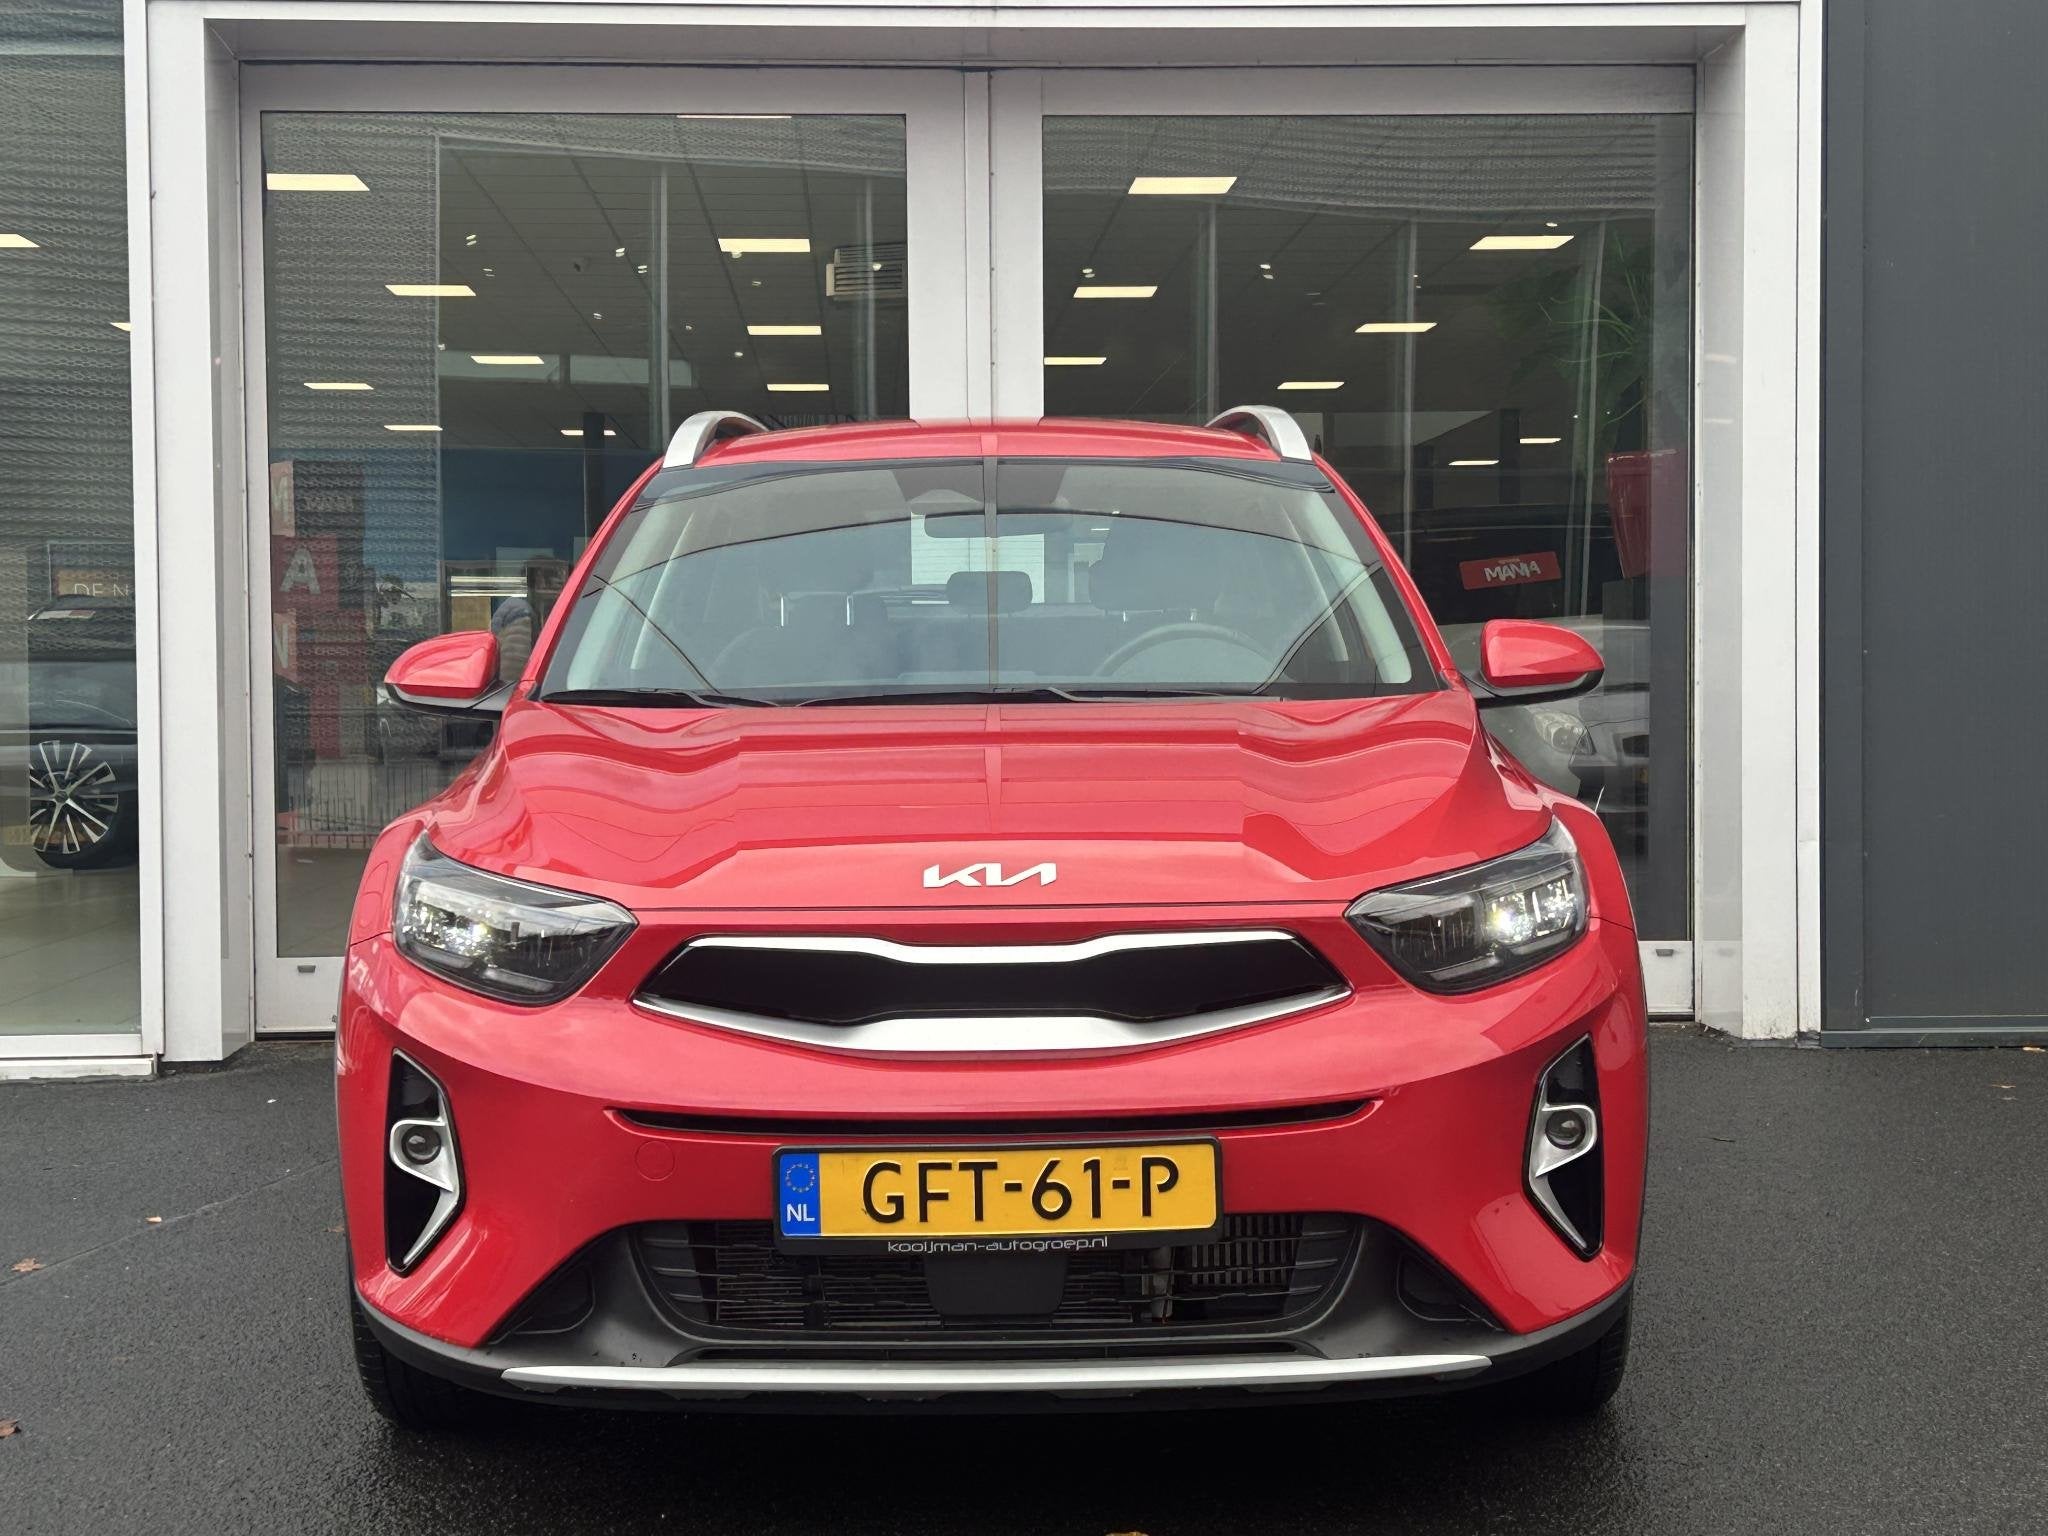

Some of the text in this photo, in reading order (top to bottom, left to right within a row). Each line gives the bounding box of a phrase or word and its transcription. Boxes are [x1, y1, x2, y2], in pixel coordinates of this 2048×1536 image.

[923, 862, 1057, 887] KIA
[862, 1155, 1180, 1224] GFT-61-P
[786, 1203, 816, 1223] NL
